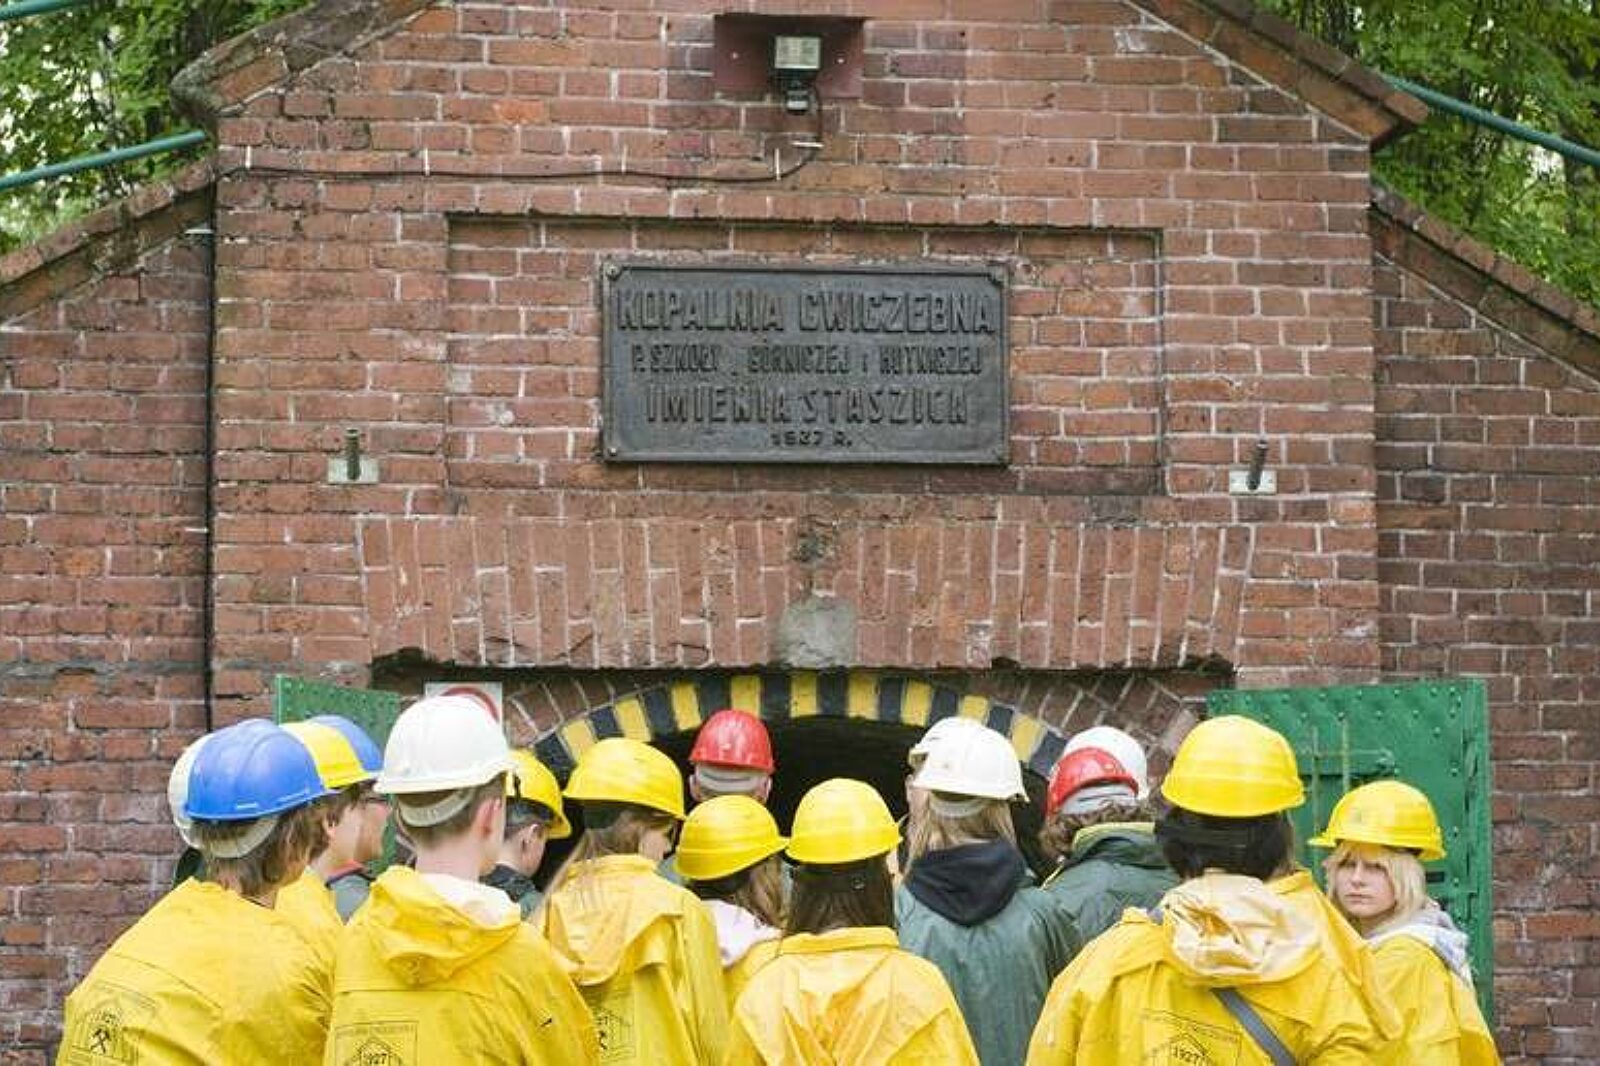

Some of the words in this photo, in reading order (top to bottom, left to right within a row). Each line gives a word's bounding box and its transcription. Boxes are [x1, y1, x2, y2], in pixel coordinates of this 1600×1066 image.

[618, 290, 784, 331] KOPALNIA
[646, 384, 791, 423] IMIENIA
[797, 386, 968, 424] STASZICA
